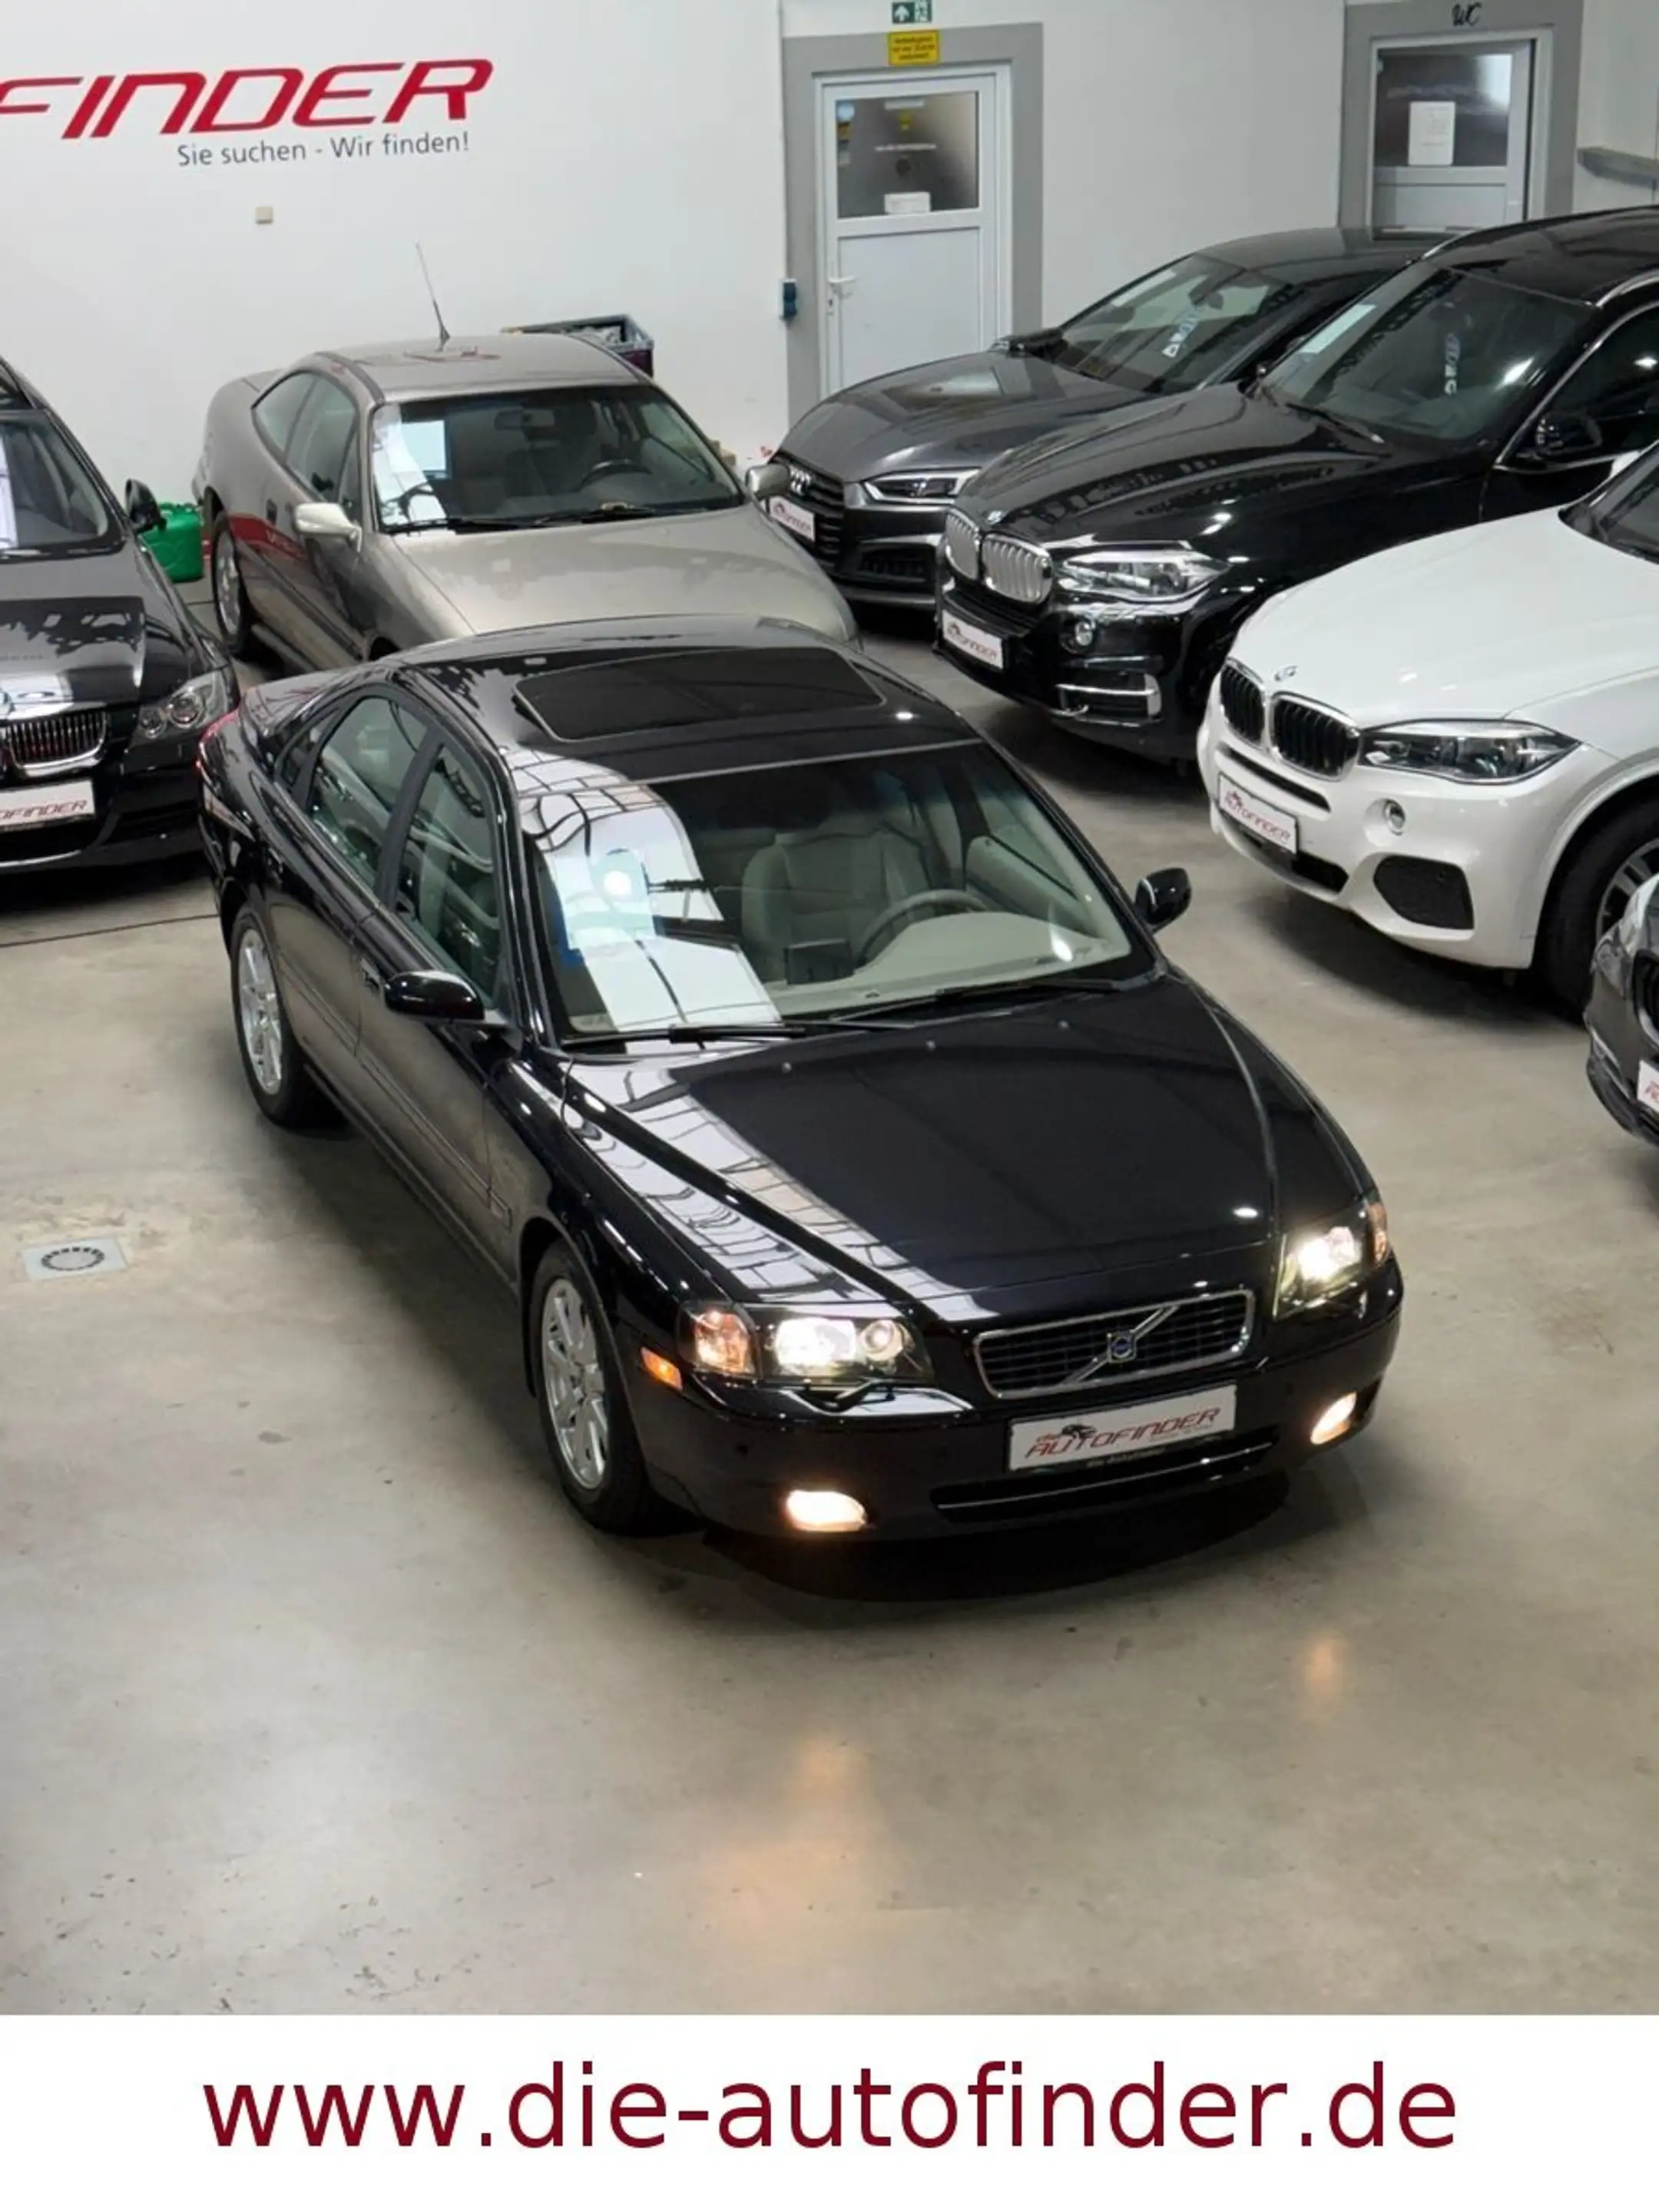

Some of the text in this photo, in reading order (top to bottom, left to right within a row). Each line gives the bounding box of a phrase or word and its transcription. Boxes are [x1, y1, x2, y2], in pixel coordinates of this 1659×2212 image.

[1452, 2, 1482, 28] WC
[177, 145, 212, 167] Sie
[220, 140, 306, 164] suchen
[330, 137, 373, 158] Wir
[382, 131, 468, 155] finden!
[1025, 1408, 1220, 1459] AUTOFINDER
